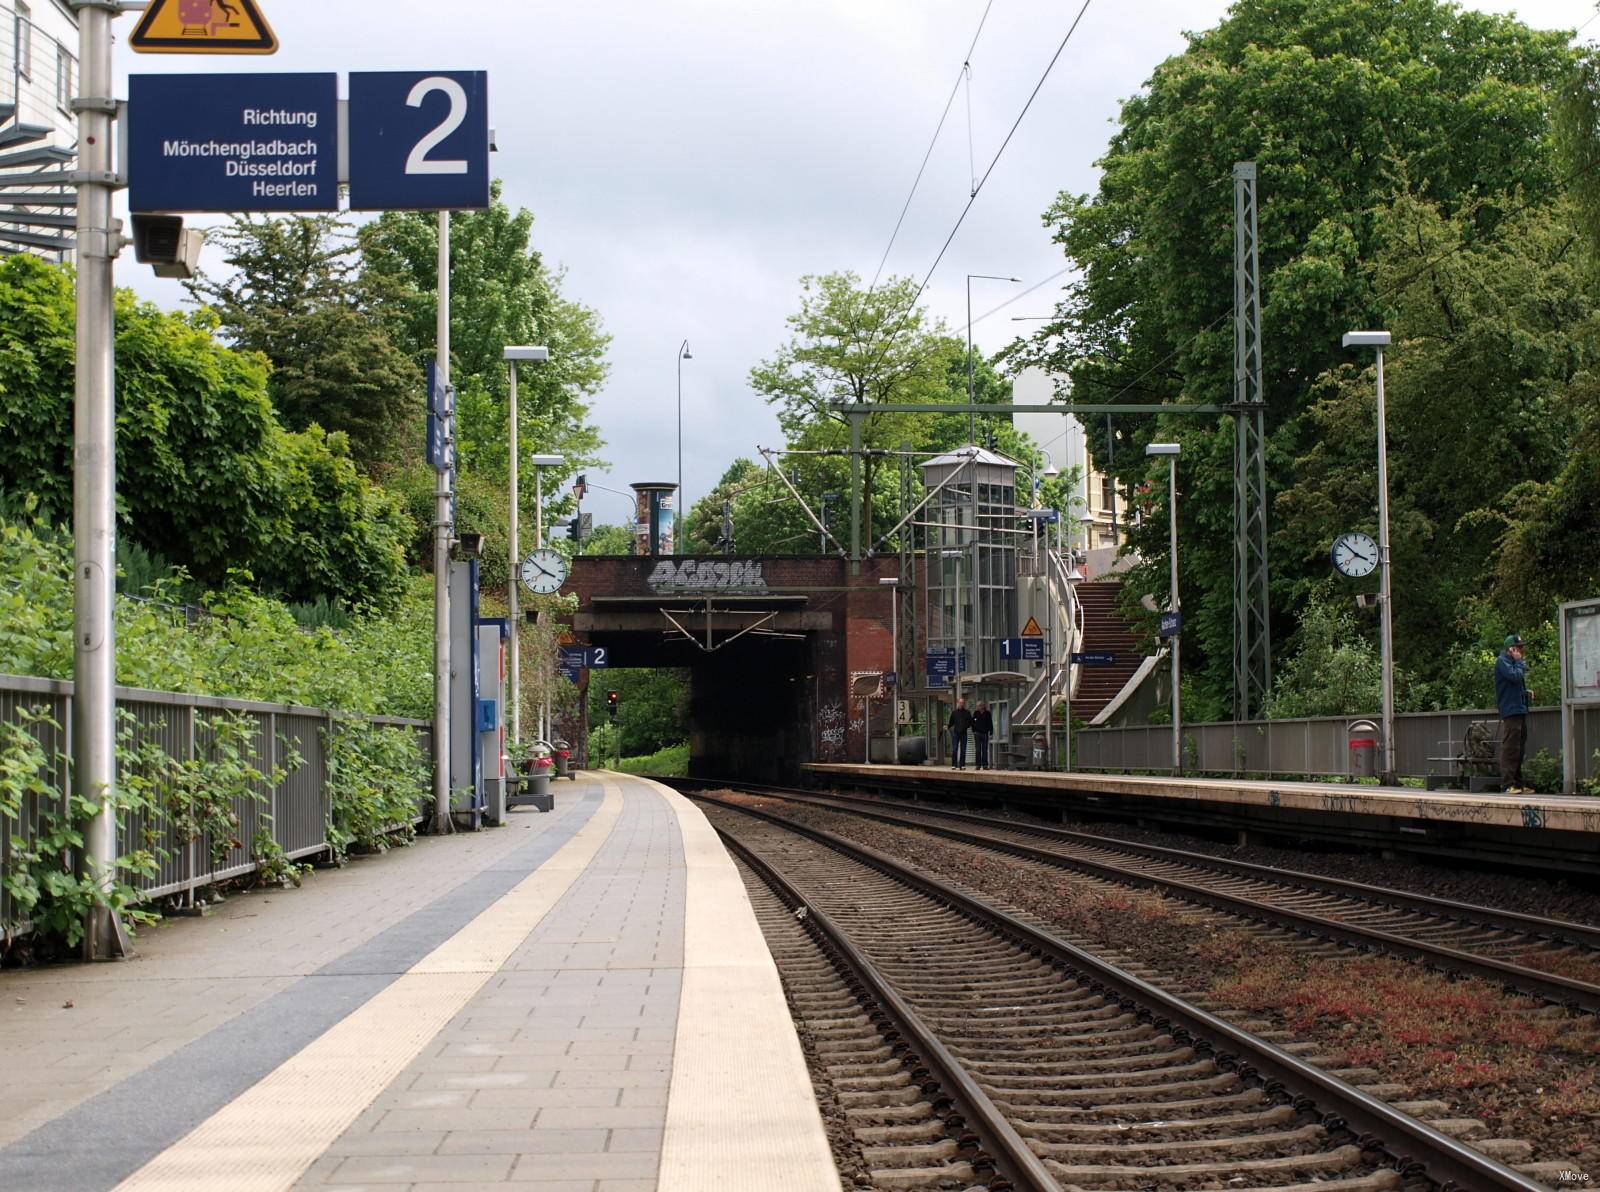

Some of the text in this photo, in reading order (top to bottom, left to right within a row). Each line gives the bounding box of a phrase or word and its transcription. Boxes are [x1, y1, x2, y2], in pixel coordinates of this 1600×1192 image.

[243, 108, 317, 128] Richtung
[404, 76, 468, 175] 2
[163, 139, 317, 159] Mönchengladbach
[225, 159, 317, 176] Düsseldorf
[252, 180, 317, 197] Heerlen
[594, 647, 605, 665] 2
[1002, 639, 1010, 656] 1
[899, 701, 906, 711] 3
[899, 711, 906, 721] 4
